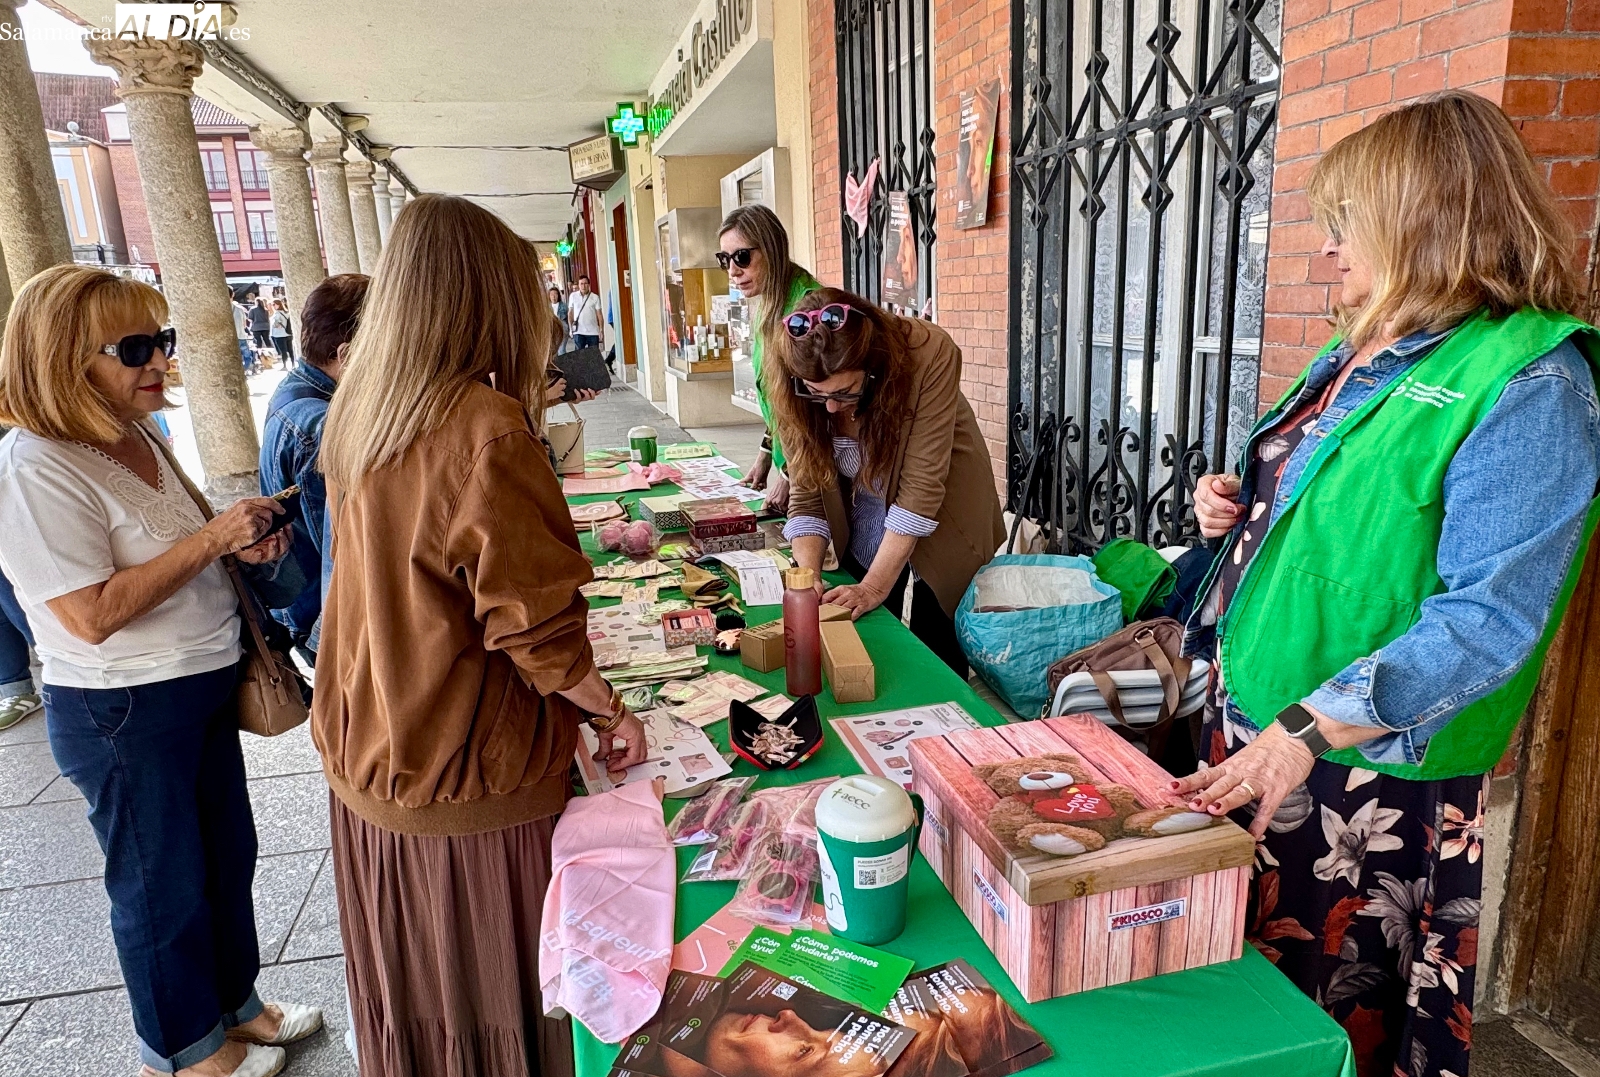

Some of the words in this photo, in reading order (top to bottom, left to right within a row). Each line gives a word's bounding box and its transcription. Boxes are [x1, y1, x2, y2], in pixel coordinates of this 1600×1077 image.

[840, 792, 871, 810] aecc
[1119, 908, 1164, 926] KIOSCO
[790, 942, 840, 962] ayudarte?
[795, 936, 830, 951] ¿Cómo
[831, 947, 879, 968] podemos
[939, 969, 957, 986] nos
[953, 984, 966, 995] lo
[929, 972, 969, 1014] tomamos
[902, 1004, 915, 1016] lo
[857, 1016, 868, 1024] a
[830, 1022, 863, 1054] pecho.
[838, 1021, 881, 1065] tomamos
[872, 1025, 891, 1043] nos
[863, 1042, 880, 1054] lo
